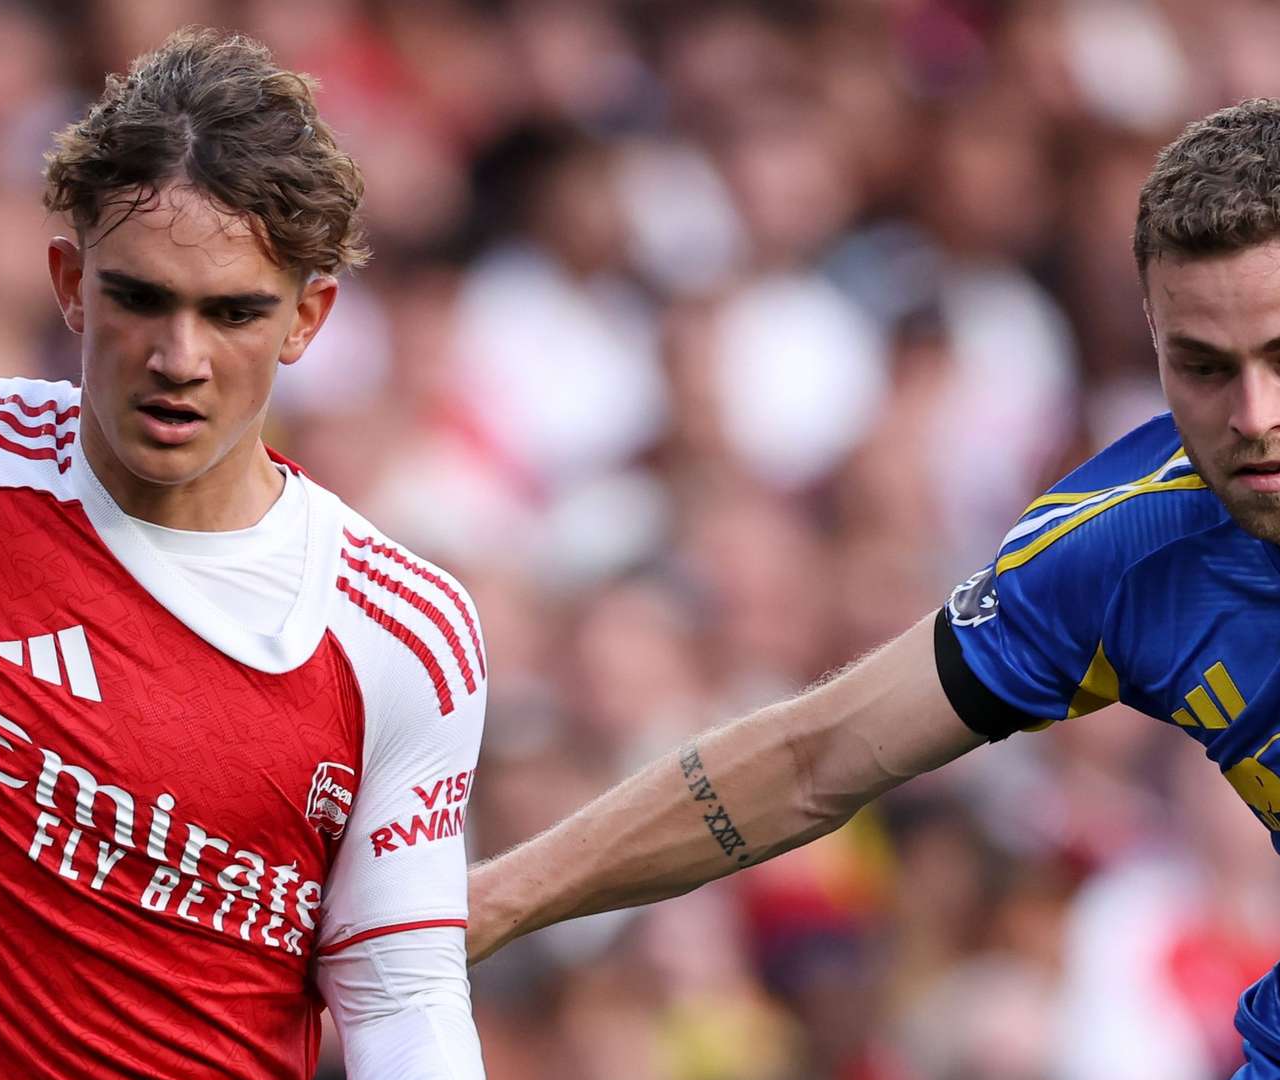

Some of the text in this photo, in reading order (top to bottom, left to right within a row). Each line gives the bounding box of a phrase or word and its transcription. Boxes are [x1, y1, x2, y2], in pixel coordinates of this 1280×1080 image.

[320, 776, 354, 806] Arsen
[411, 769, 477, 809] VISI
[28, 811, 127, 890] FLY
[369, 806, 465, 857] RWAN
